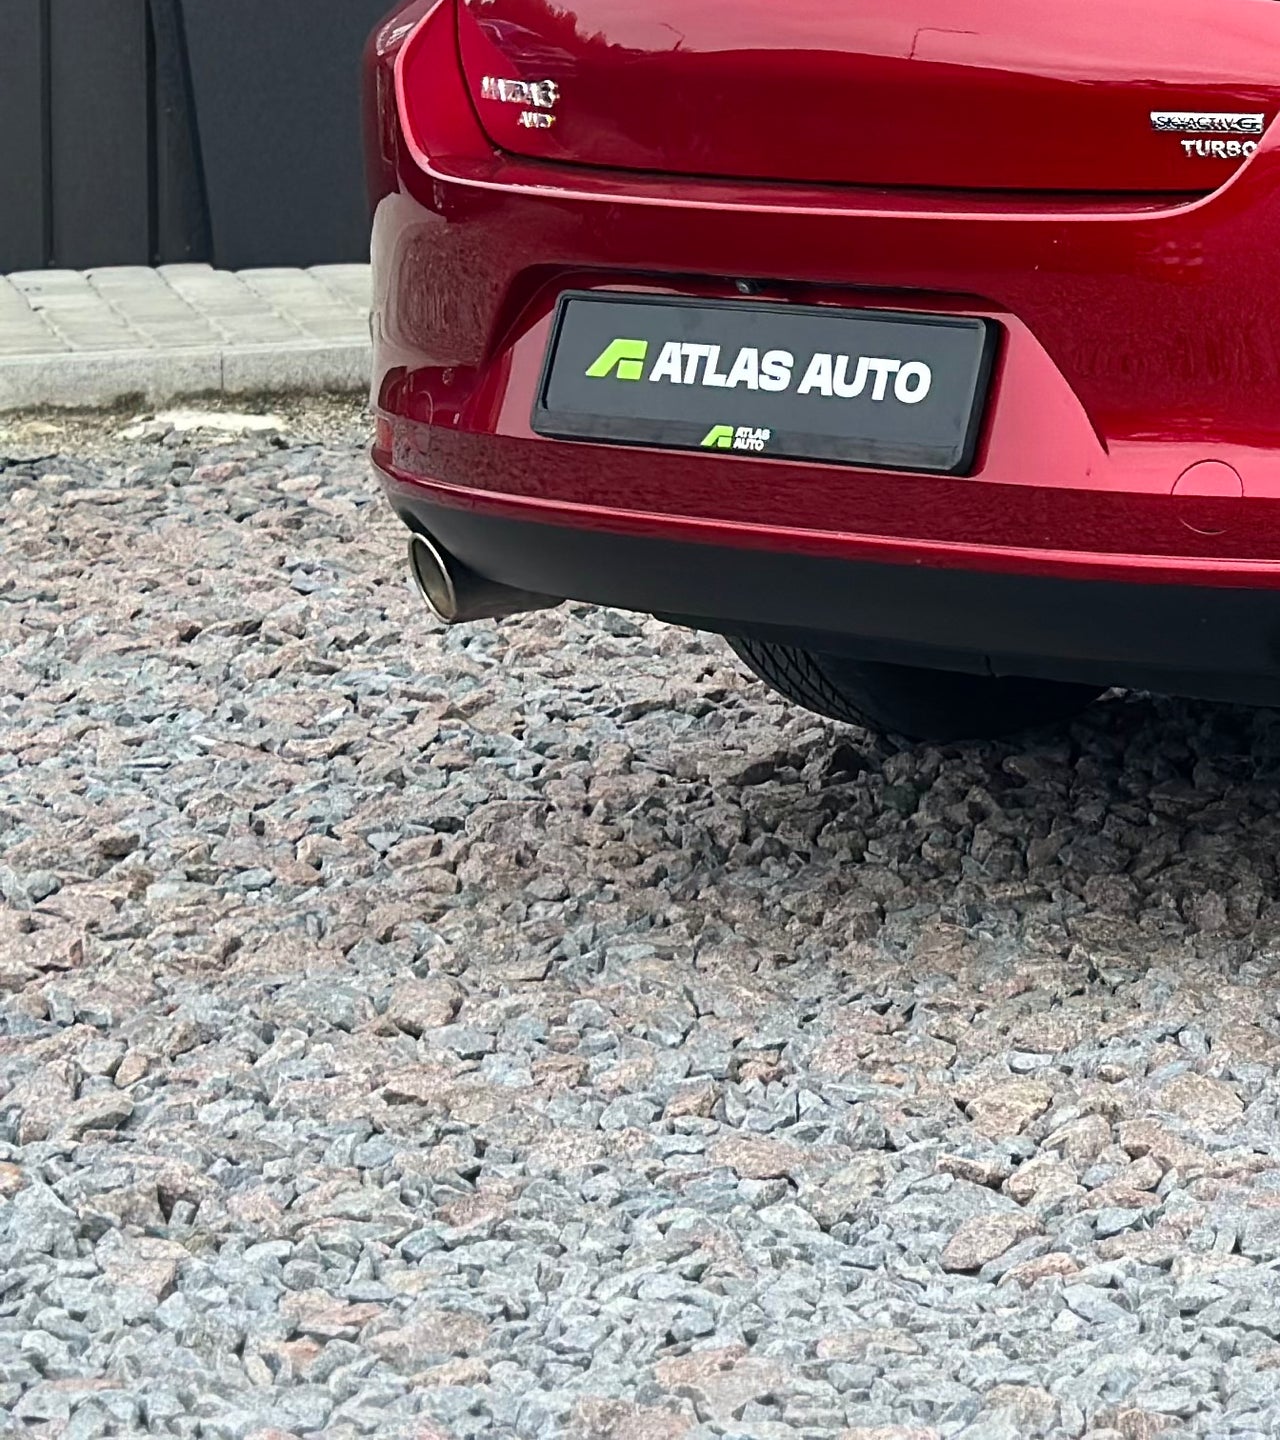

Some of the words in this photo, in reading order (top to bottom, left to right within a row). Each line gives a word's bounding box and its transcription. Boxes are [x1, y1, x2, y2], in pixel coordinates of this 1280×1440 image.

[1181, 139, 1257, 158] TURBO
[649, 341, 795, 392] ATLAS
[797, 352, 933, 405] AUTO
[735, 426, 771, 441] ATLAS
[733, 437, 764, 451] AUTO
